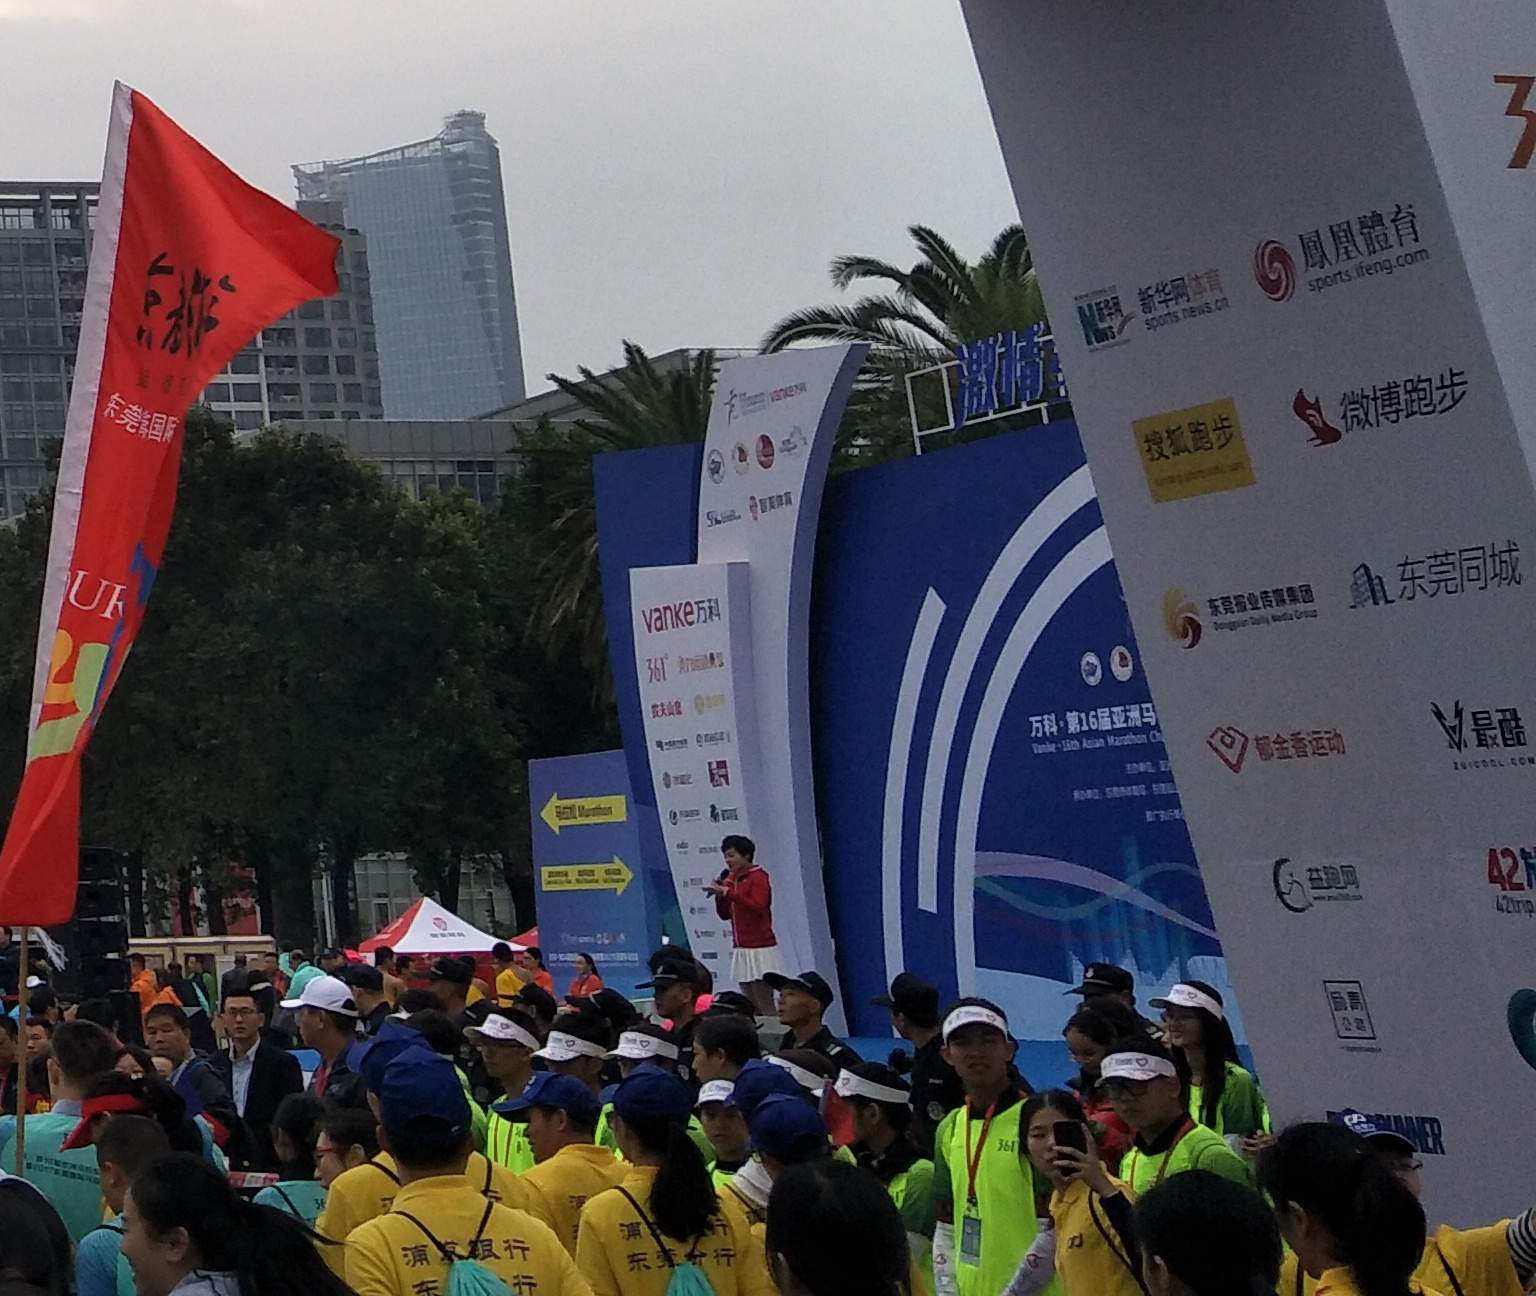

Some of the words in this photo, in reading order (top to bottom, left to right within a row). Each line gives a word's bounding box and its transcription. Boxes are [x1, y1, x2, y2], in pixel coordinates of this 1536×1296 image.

[1298, 203, 1421, 273] 鳳凰體育
[1307, 247, 1430, 294] sports.ifeng.com
[1339, 367, 1469, 434] 微博跑步
[1395, 539, 1522, 601] 东莞同城
